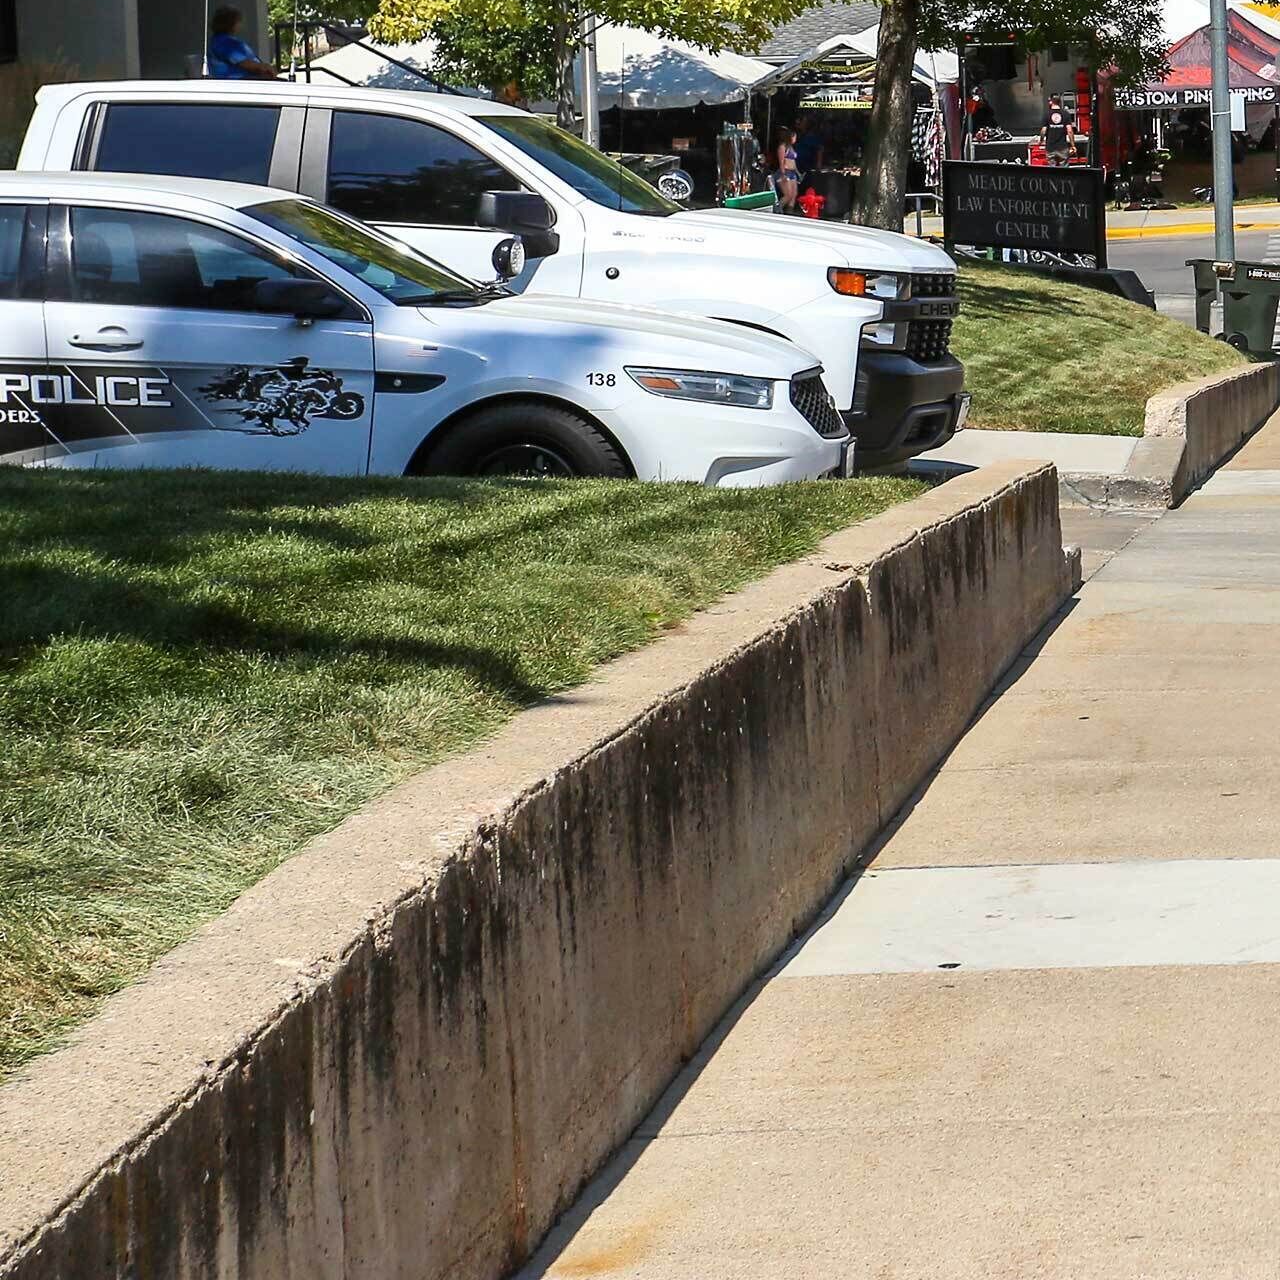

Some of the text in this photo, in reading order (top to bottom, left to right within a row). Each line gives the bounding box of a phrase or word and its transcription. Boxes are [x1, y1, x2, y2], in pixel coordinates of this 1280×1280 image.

[1184, 87, 1275, 104] PINPING
[967, 173, 1078, 196] MEADE COUNTY
[957, 195, 1091, 220] LAW ENFORCEMENT
[995, 221, 1050, 240] CENTER
[0, 373, 173, 407] POLICE
[584, 372, 617, 388] 138
